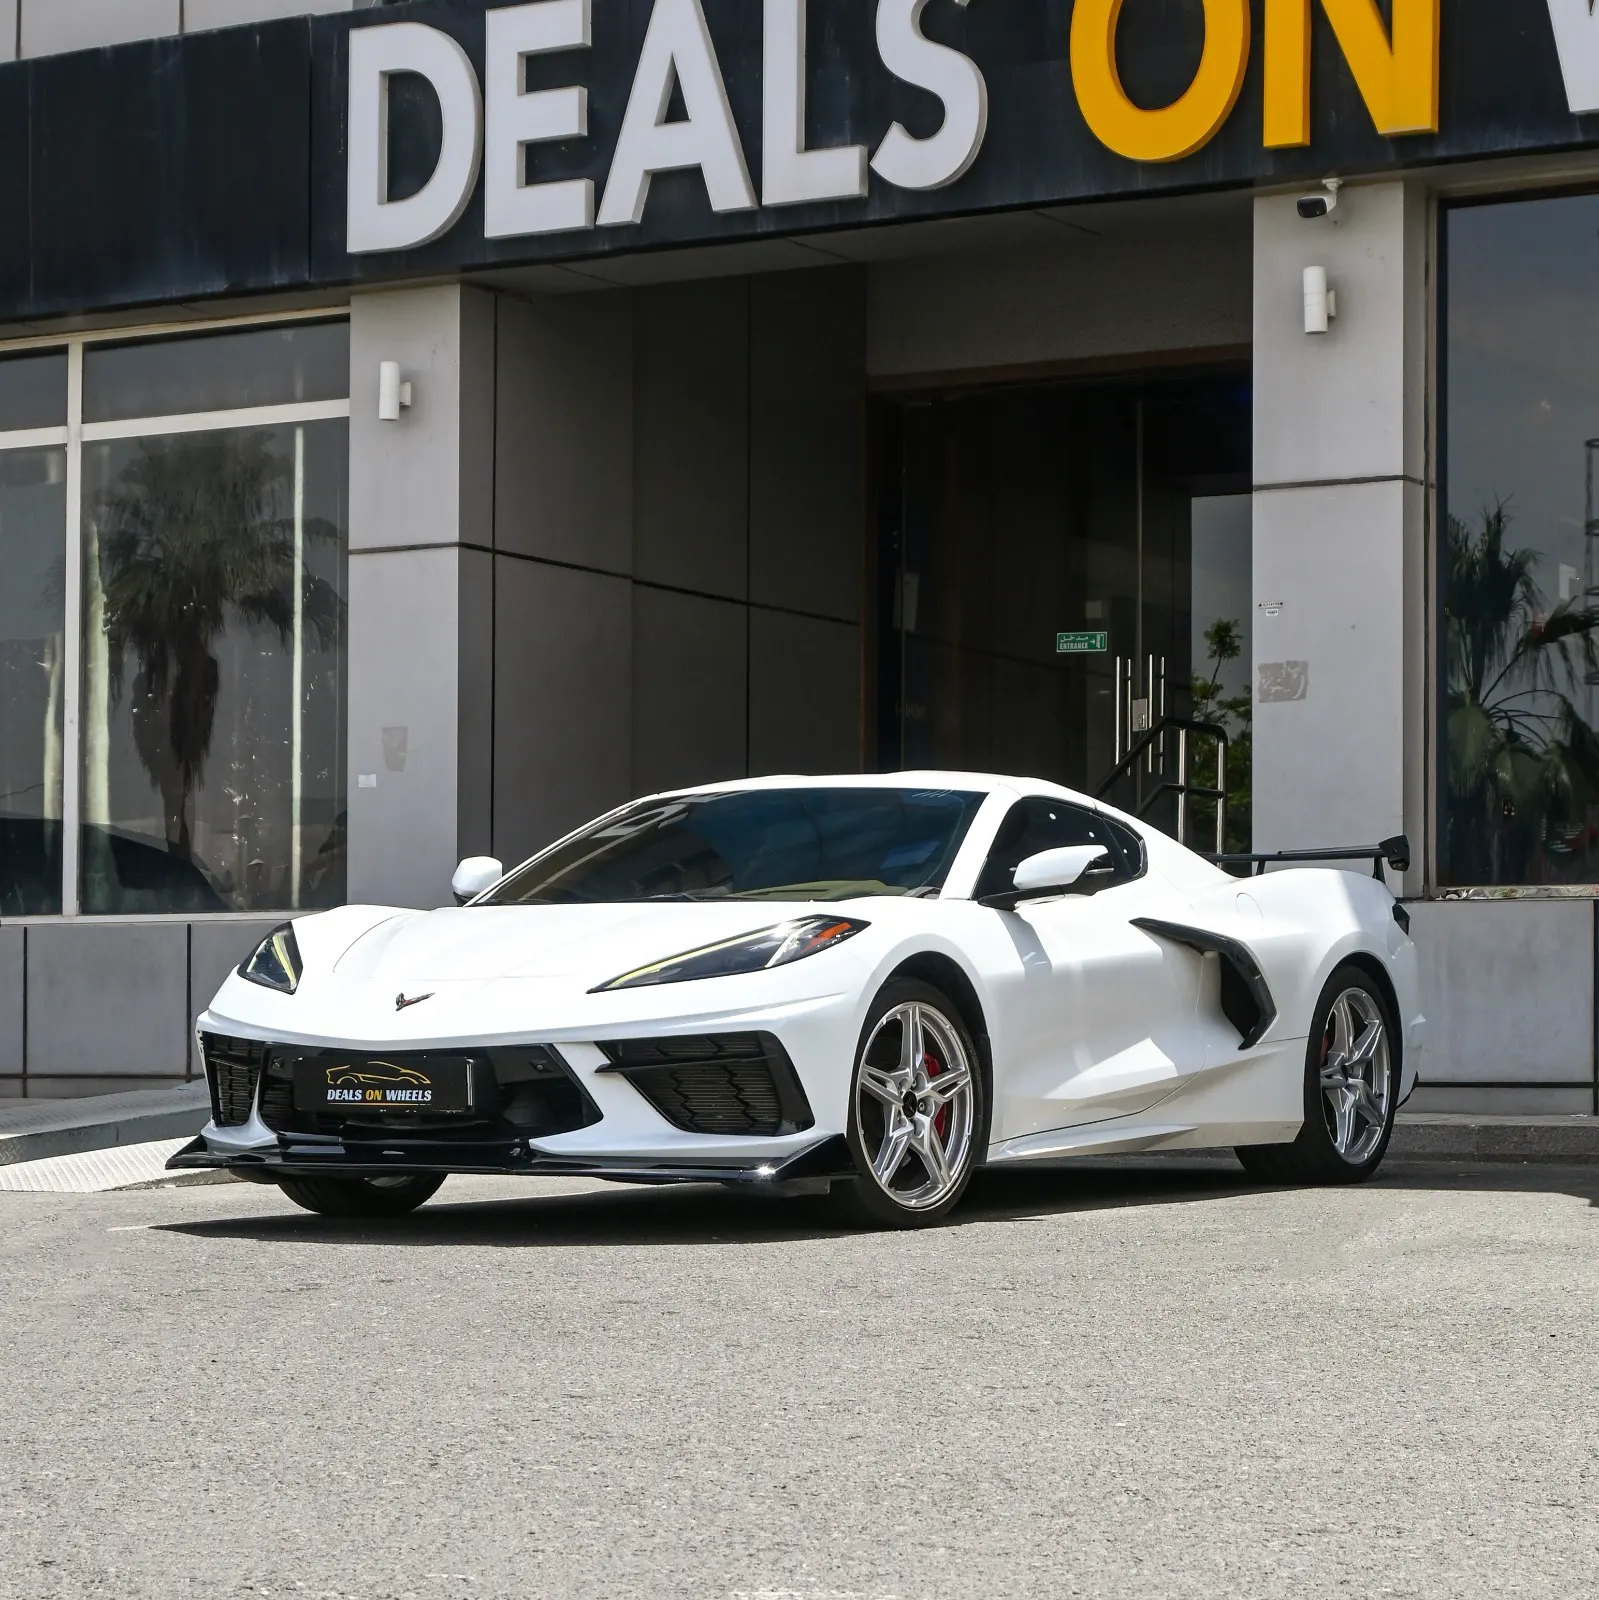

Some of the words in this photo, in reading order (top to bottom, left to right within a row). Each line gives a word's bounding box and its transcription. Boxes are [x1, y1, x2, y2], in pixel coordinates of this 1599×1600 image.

[346, 0, 988, 255] DEALS
[1069, 0, 1439, 162] ON
[1060, 635, 1089, 643] مدخل
[1059, 642, 1089, 650] ENTRANCE
[326, 1089, 362, 1101] DEALS
[365, 1089, 383, 1101] ON
[385, 1089, 432, 1101] WHEELS
